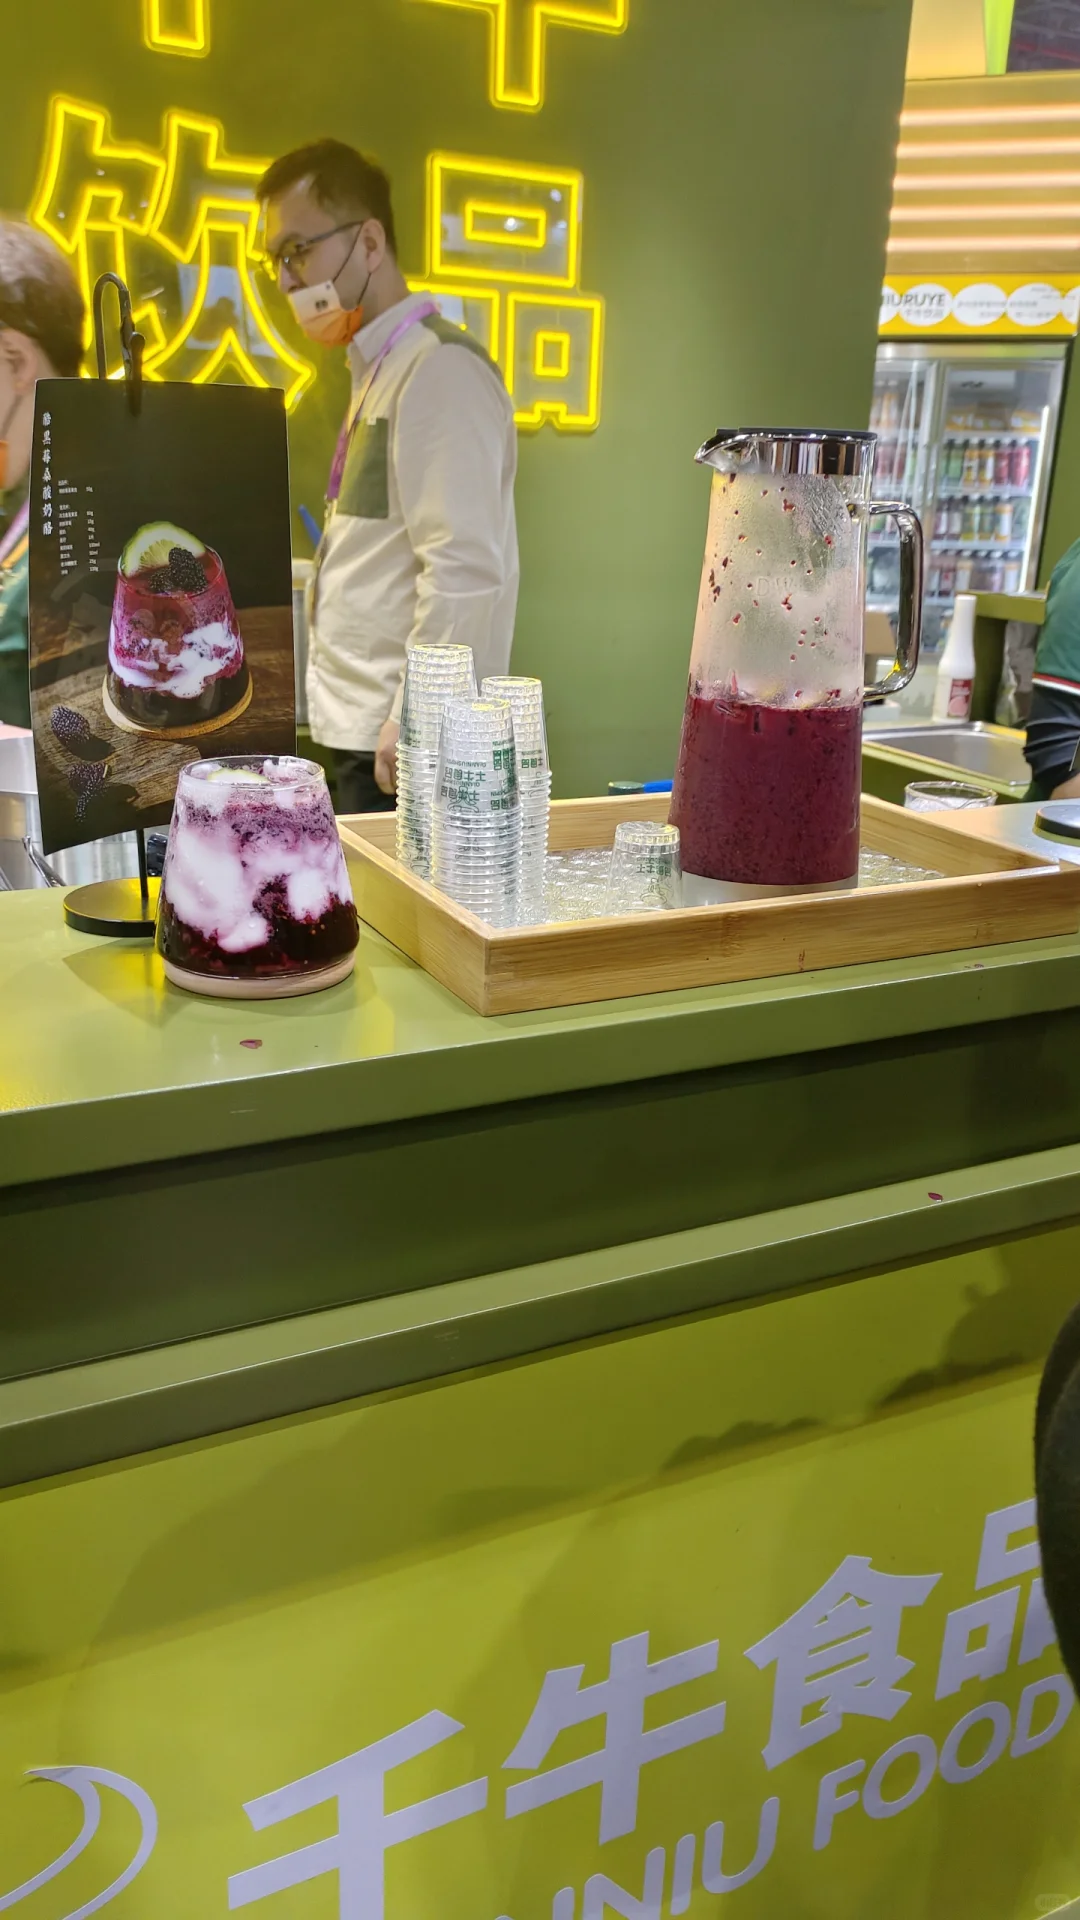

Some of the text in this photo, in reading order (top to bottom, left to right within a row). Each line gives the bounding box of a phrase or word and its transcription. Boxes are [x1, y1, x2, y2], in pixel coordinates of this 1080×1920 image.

[31, 95, 605, 434] 饮品
[228, 1497, 1060, 1920] 千牛食品
[812, 1673, 1075, 1851] FOOD
